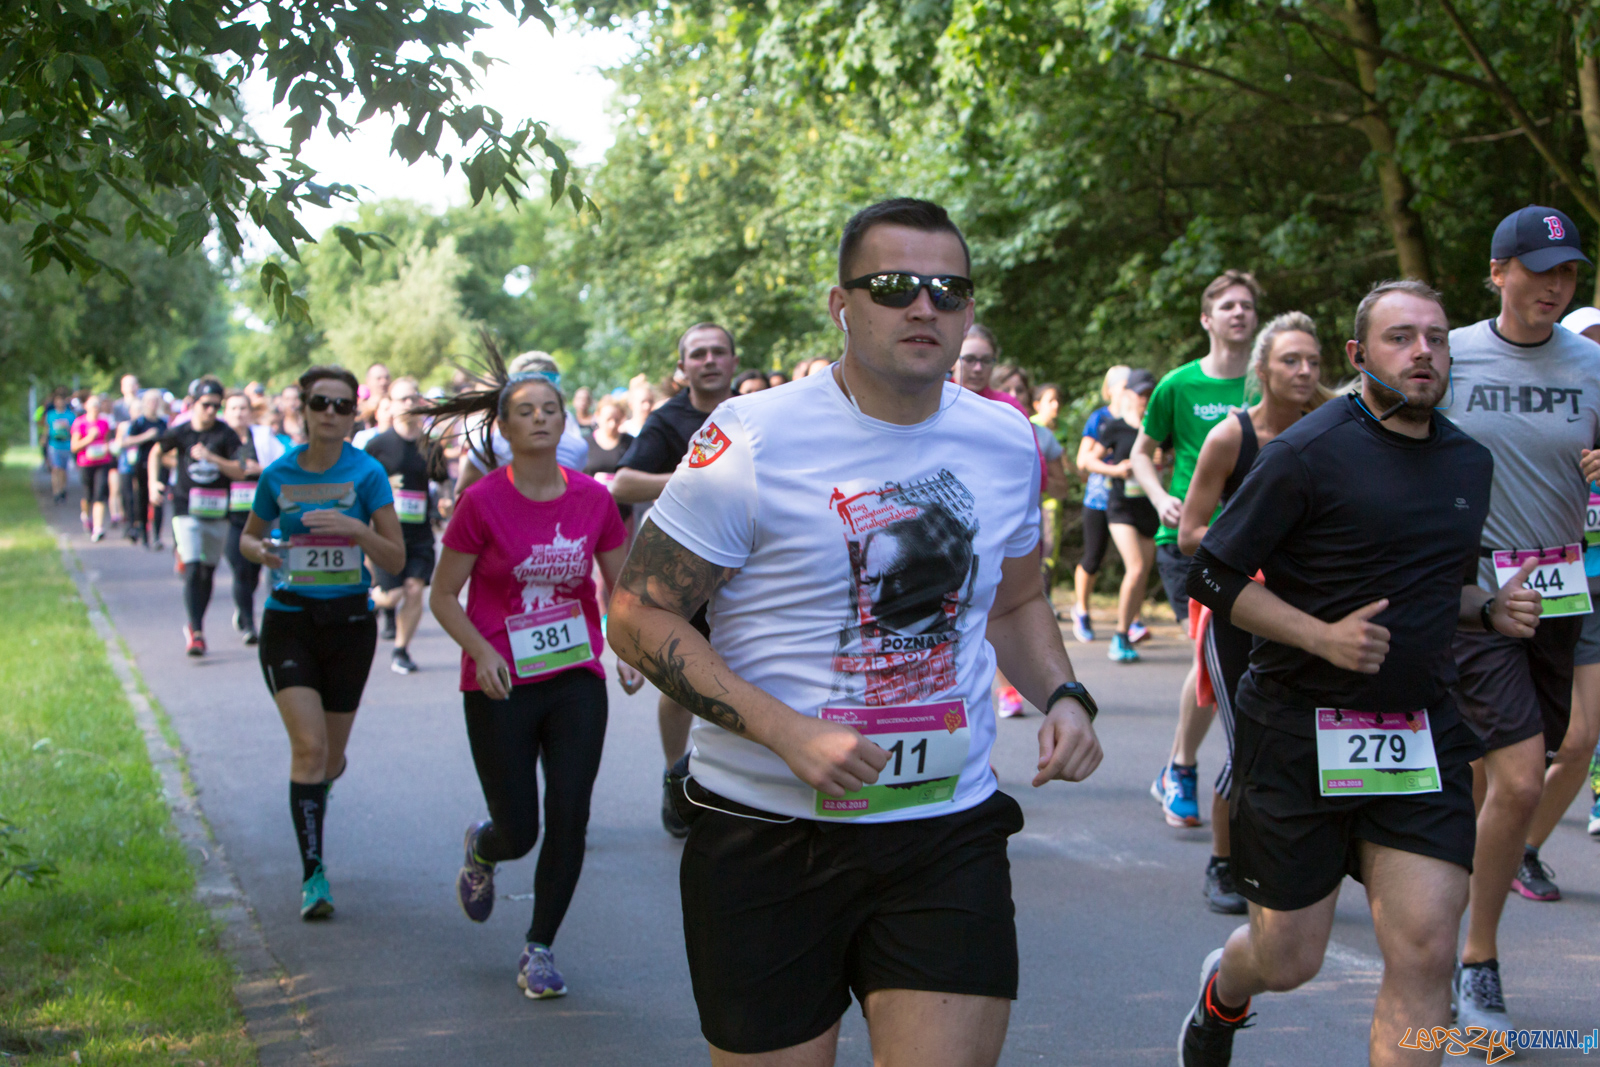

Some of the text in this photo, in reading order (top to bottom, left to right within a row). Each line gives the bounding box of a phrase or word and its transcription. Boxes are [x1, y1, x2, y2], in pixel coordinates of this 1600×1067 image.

[1543, 215, 1565, 240] B
[1466, 384, 1582, 414] ATHDPT
[848, 503, 869, 514] bieg
[854, 504, 895, 526] powstania
[858, 507, 919, 533] wielkopolskiego
[306, 549, 345, 568] 218
[530, 622, 571, 652] 381
[841, 648, 932, 671] 27.12.2017
[873, 738, 928, 776] 11
[1347, 734, 1407, 763] 279
[824, 800, 867, 809] 22.06.2018
